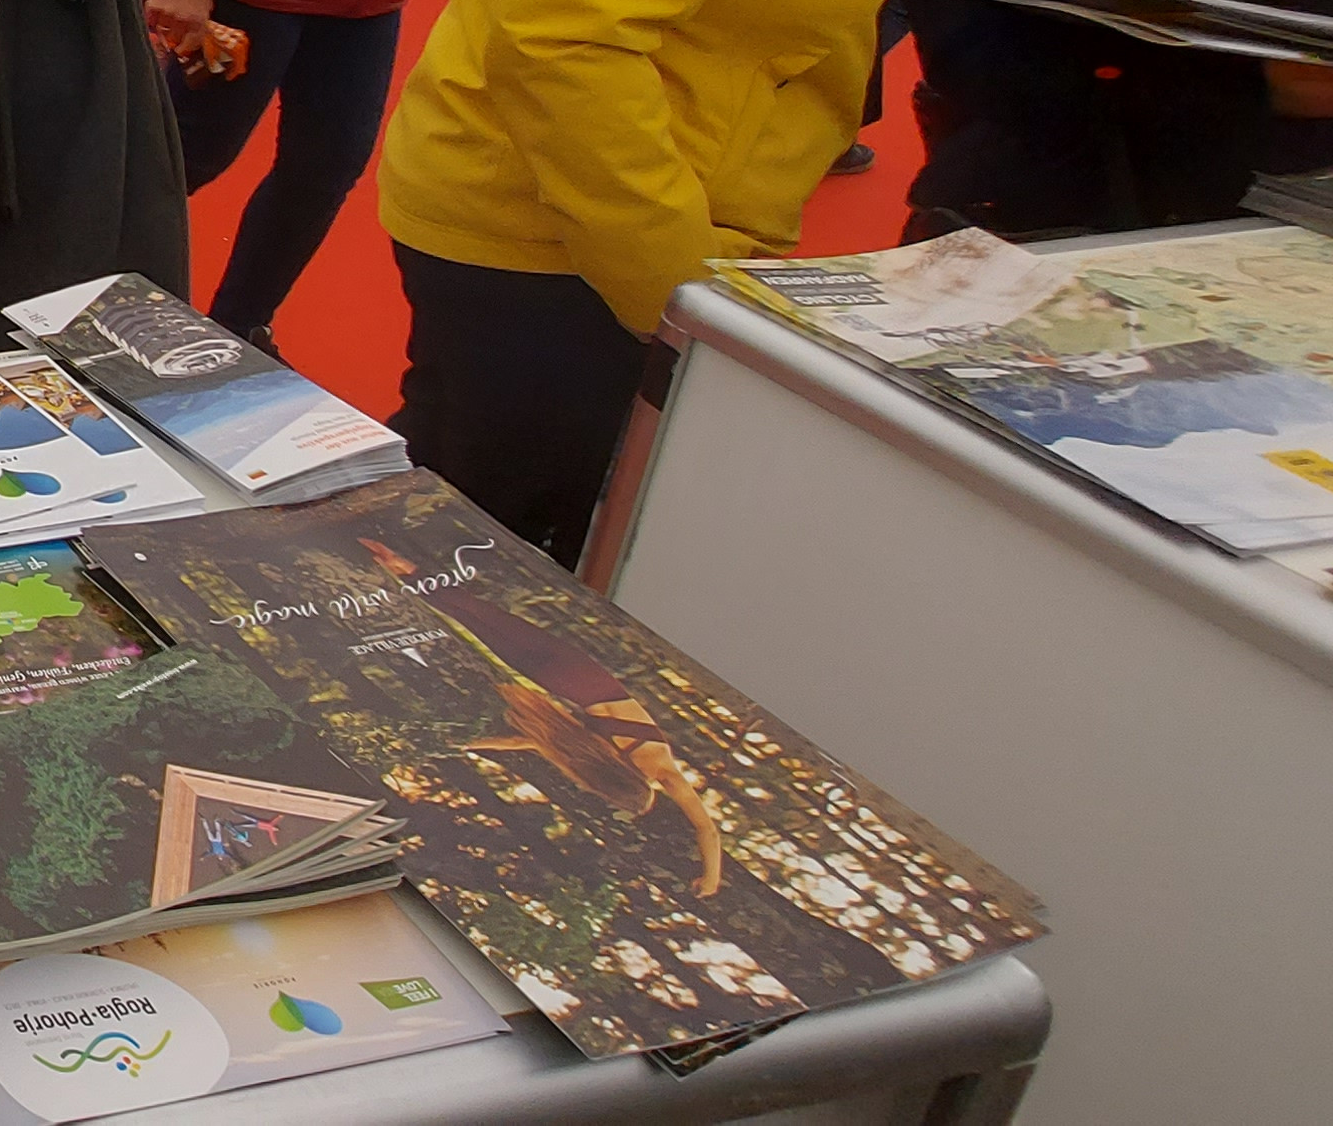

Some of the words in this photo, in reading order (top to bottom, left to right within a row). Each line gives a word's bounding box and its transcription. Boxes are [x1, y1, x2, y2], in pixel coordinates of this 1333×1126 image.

[761, 274, 872, 285] RADFAHREN
[792, 293, 878, 305] CYCLING
[400, 538, 495, 597] green
[329, 588, 391, 619] wild
[209, 600, 319, 629] magic
[71, 656, 132, 672] Entdecken,
[27, 665, 69, 680] Fühlen,
[252, 976, 298, 990] POHORJE
[406, 987, 431, 1002] FEEL
